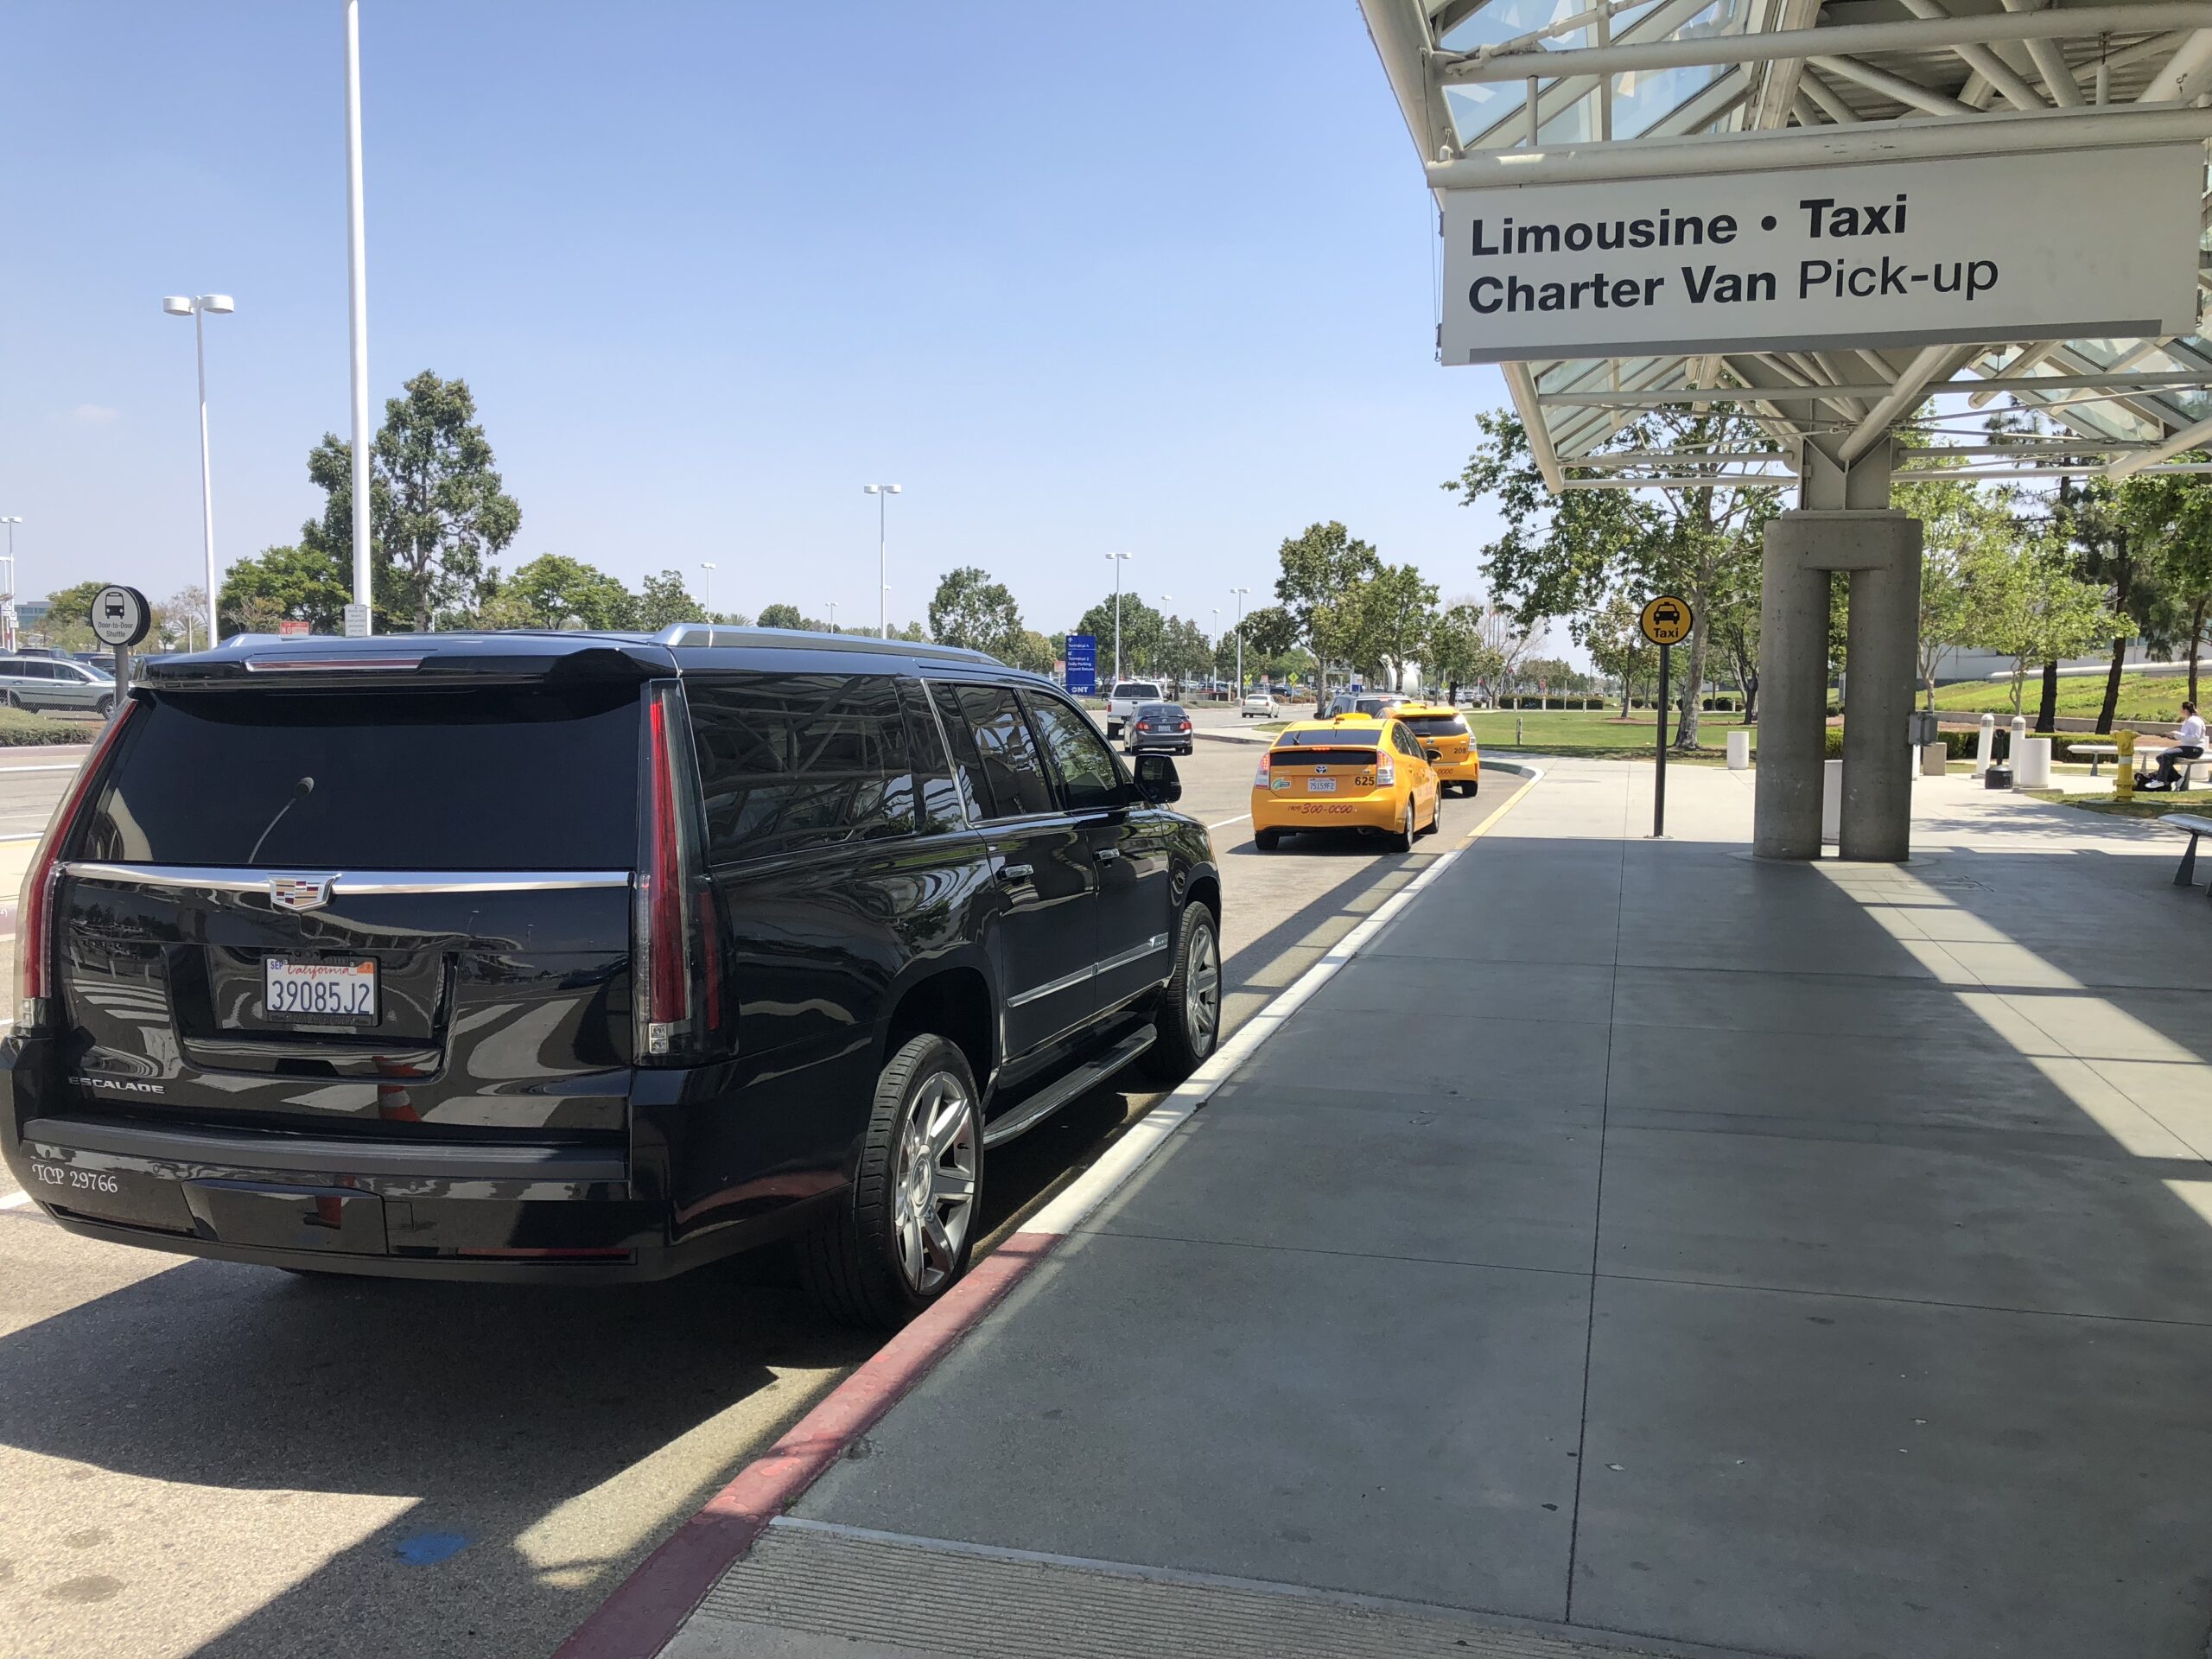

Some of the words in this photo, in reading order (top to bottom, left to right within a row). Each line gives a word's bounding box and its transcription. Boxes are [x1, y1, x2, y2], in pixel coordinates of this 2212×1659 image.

[1472, 208, 1738, 256] Limousine
[1800, 194, 1908, 238] Taxi
[1468, 272, 1665, 315] Charter
[1681, 262, 1777, 304] Van
[1799, 255, 1999, 301] Pick-up
[1654, 627, 1679, 638] Taxi
[1355, 777, 1375, 785] 625
[270, 961, 283, 969] SEP
[288, 965, 356, 979] California
[271, 980, 370, 1014] 39085J2
[68, 1077, 165, 1094] ESCALADE
[32, 1164, 64, 1185] TCP
[70, 1171, 118, 1193] 29766
